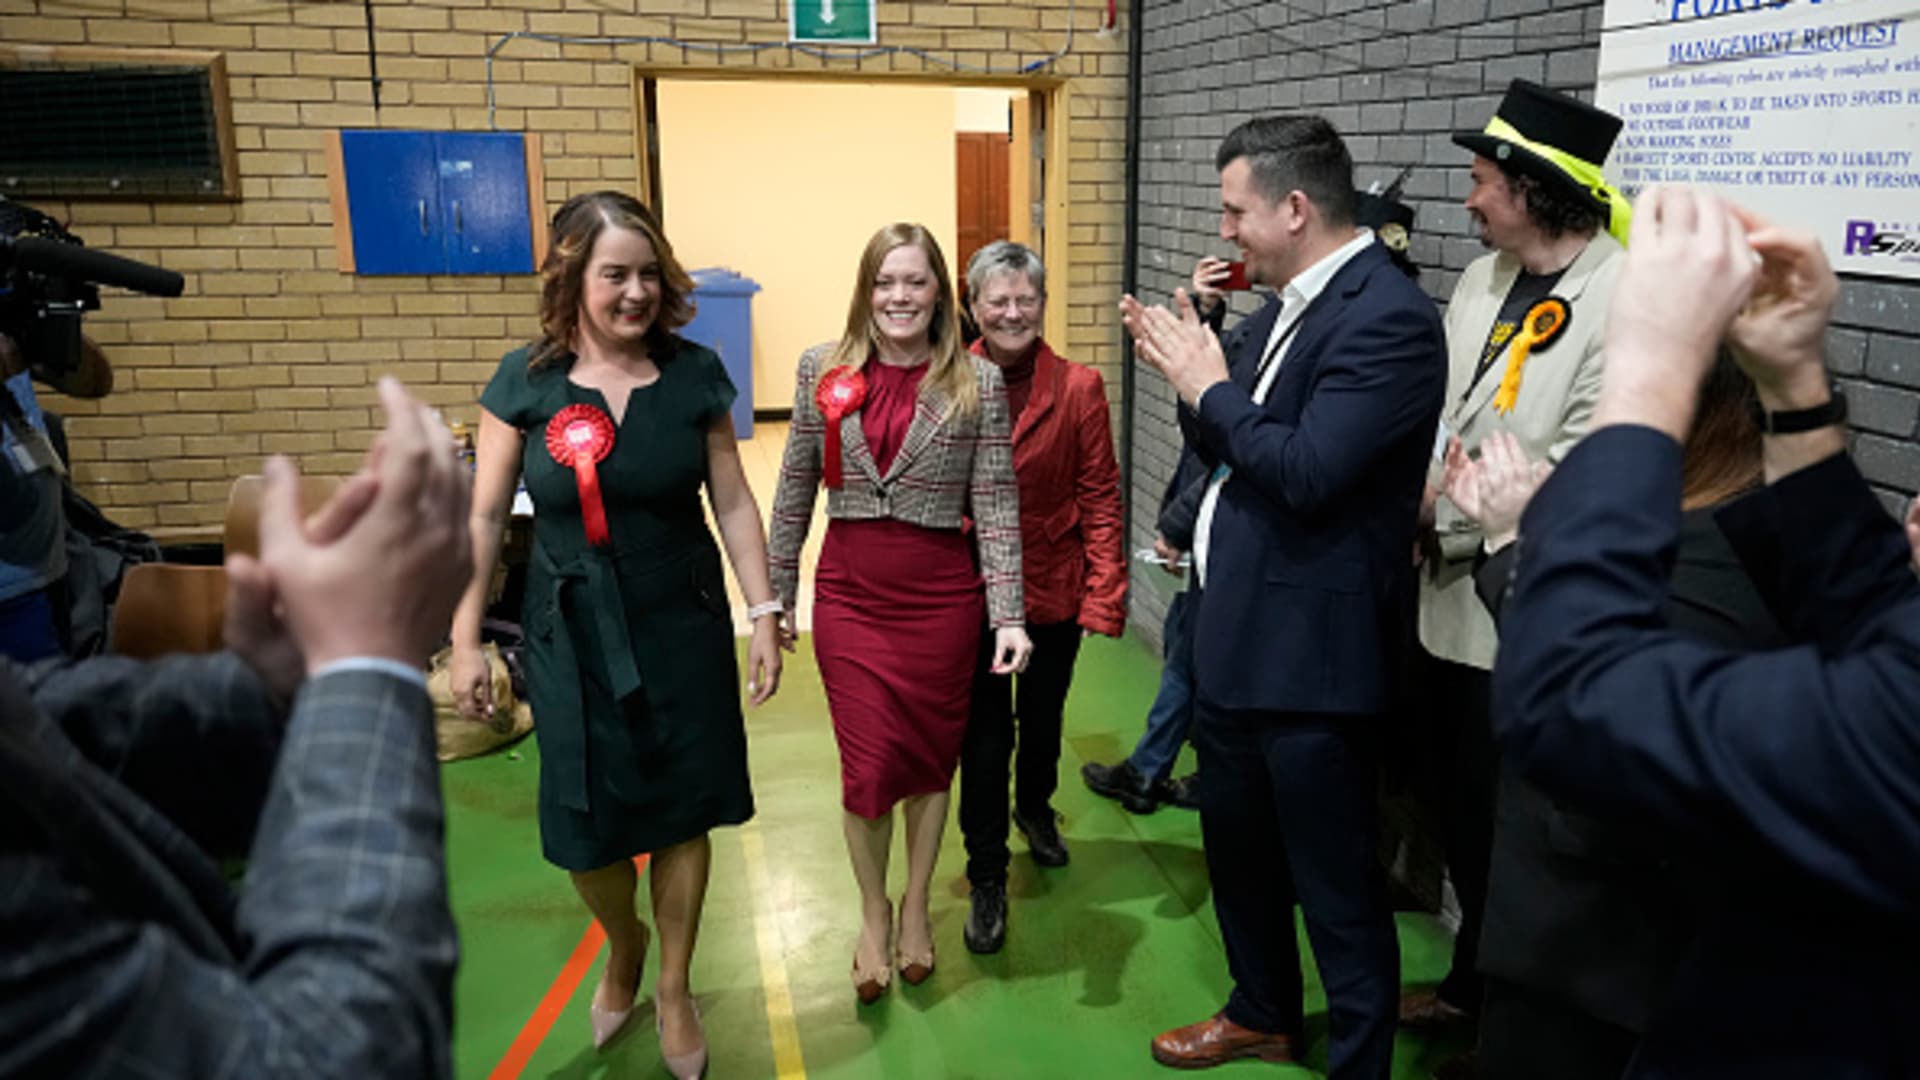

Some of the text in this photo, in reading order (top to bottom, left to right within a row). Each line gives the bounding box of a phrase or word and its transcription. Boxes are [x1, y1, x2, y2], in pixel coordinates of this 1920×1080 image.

[1668, 19, 1902, 63] MANAGEMENT REQUEST
[1732, 96, 1747, 110] TO
[1750, 96, 1767, 110] BE
[1770, 94, 1811, 110] TAKEN
[1813, 93, 1847, 107] INTO
[1850, 89, 1902, 106] SPORTS
[1687, 116, 1751, 130] FOOTWEAR
[1671, 151, 1709, 165] SPORTS
[1713, 151, 1757, 165] CENTRE
[1760, 151, 1813, 166] ACCEPTS
[1817, 151, 1838, 165] NO
[1842, 151, 1912, 166] LIABILITY
[1746, 171, 1764, 185] OR
[1767, 171, 1807, 185] THEFT
[1810, 171, 1826, 185] OF
[1833, 171, 1859, 187] ANY
